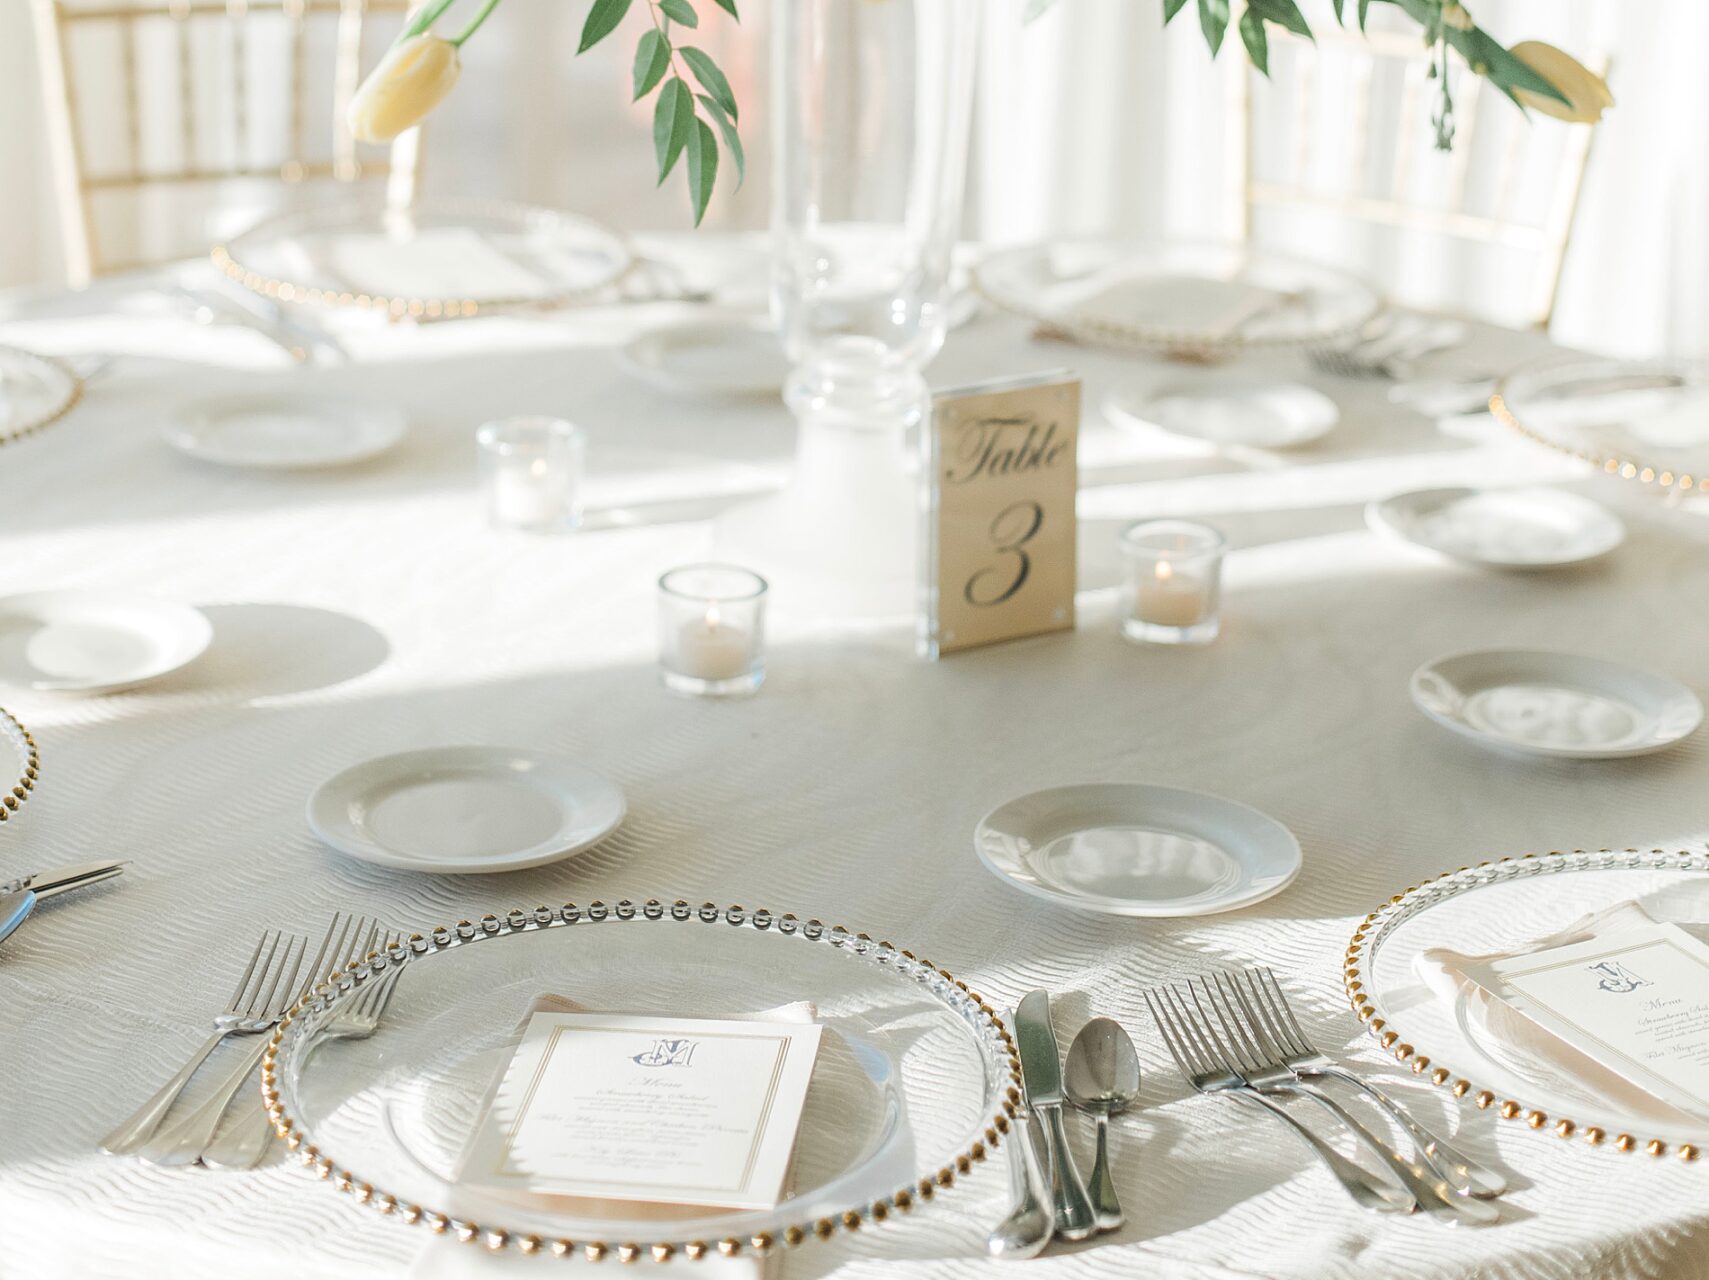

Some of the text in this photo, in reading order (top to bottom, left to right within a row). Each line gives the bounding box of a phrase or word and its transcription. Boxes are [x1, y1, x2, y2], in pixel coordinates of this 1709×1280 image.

[946, 418, 1068, 483] Table
[964, 500, 1044, 608] 3
[1640, 997, 1682, 1012] Menu
